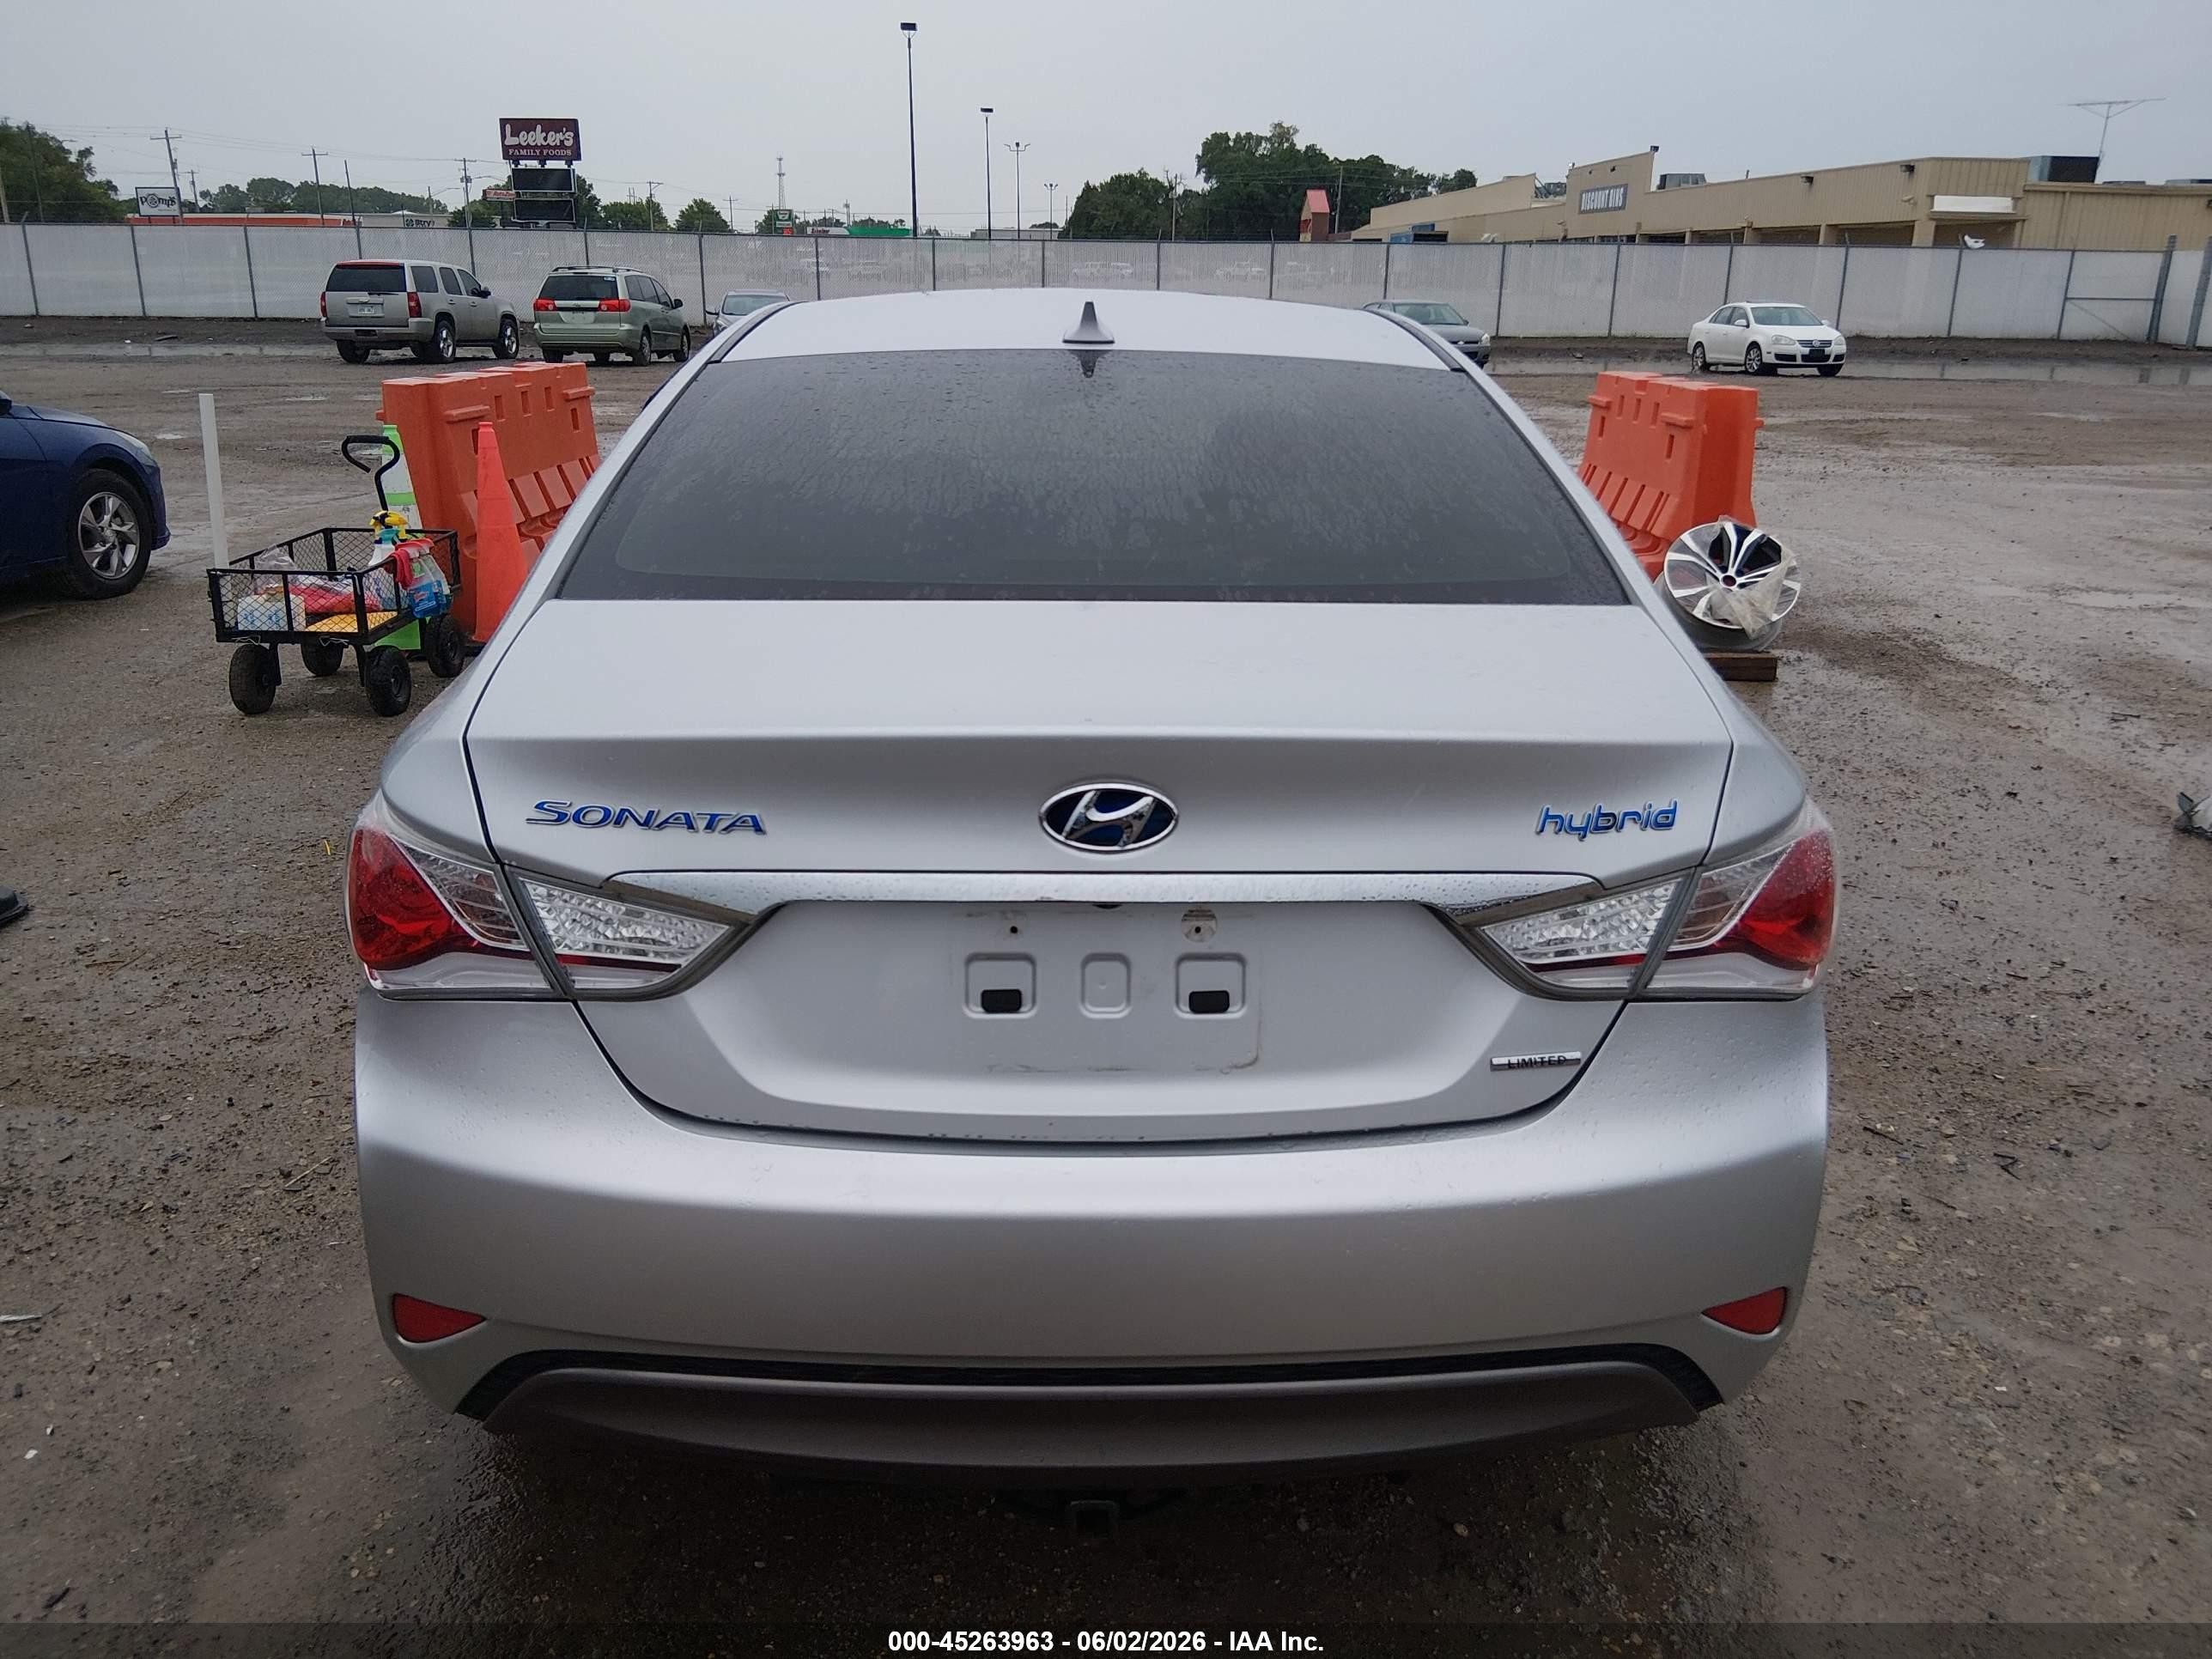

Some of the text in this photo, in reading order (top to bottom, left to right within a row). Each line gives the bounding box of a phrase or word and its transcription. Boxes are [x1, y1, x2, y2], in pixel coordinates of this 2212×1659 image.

[504, 124, 574, 147] Leeker's
[525, 799, 767, 836] SONATA
[1535, 799, 1679, 842] hybrid
[1507, 1055, 1567, 1070] LIMITED
